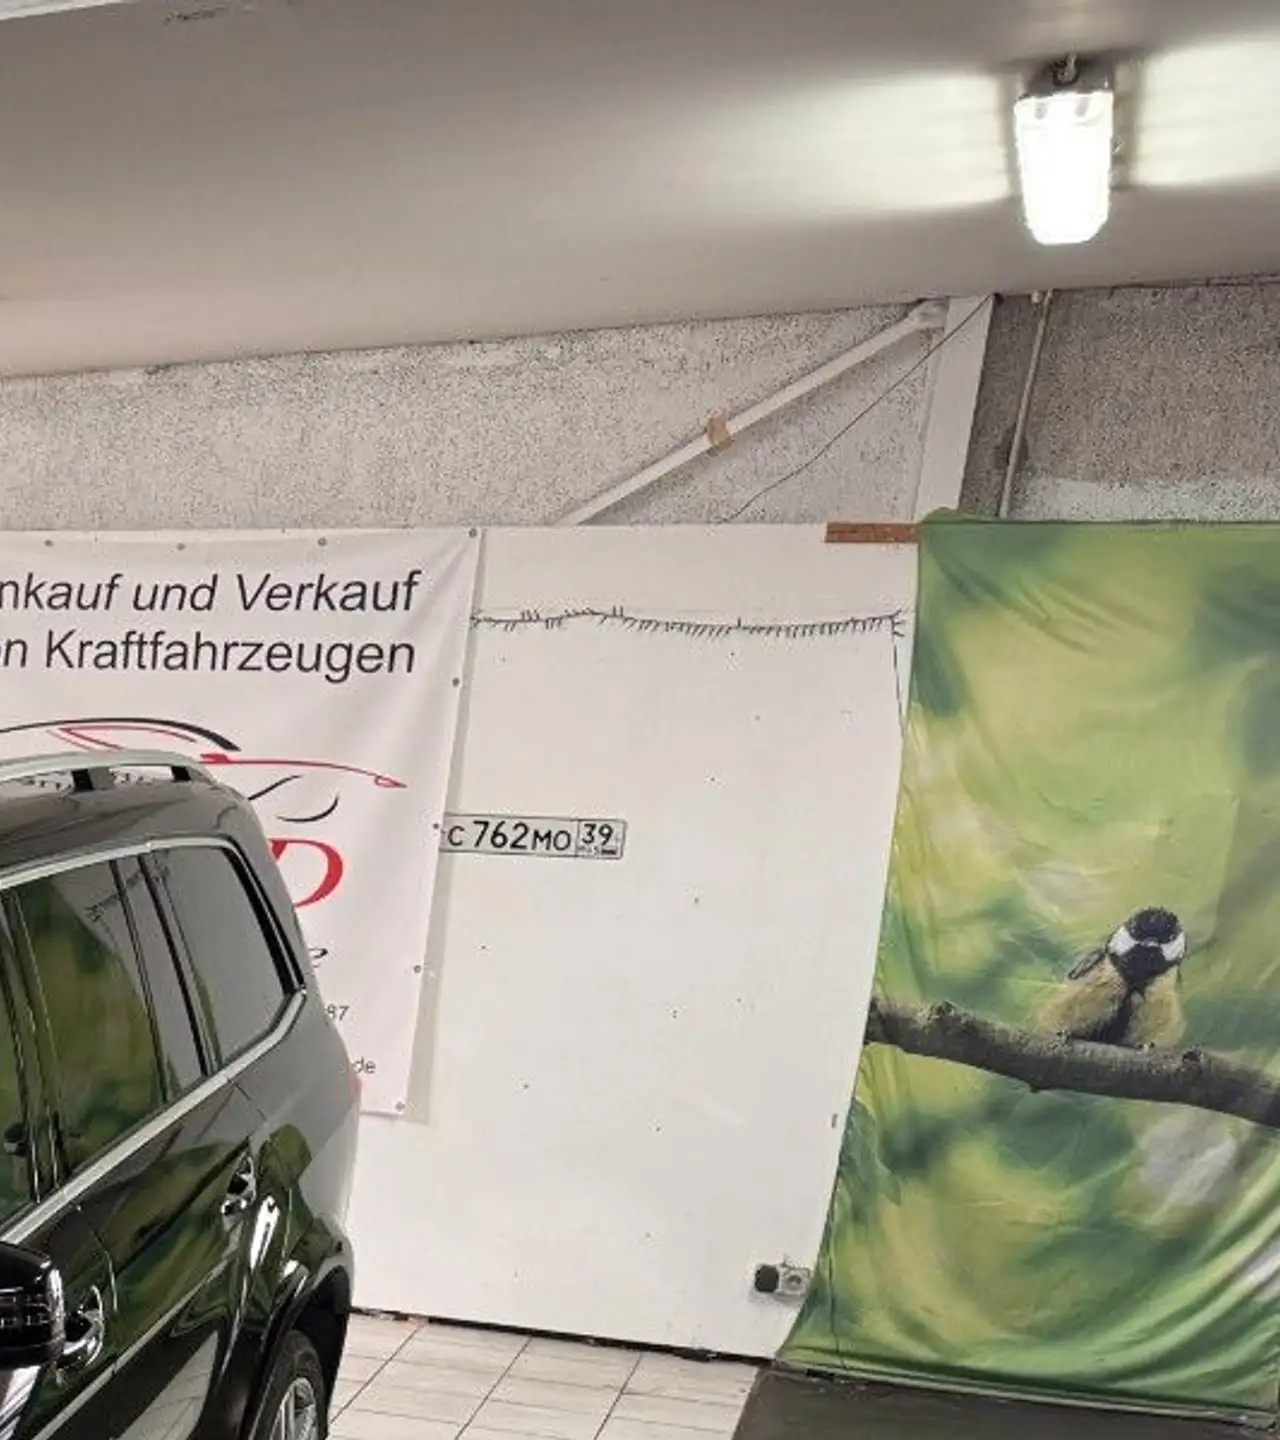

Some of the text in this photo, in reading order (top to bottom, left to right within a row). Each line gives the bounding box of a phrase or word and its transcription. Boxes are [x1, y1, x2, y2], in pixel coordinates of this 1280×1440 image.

[132, 573, 218, 611] und
[236, 569, 421, 611] Verkauf
[45, 629, 416, 683] Kraftfahrzeugen
[580, 823, 613, 846] 39
